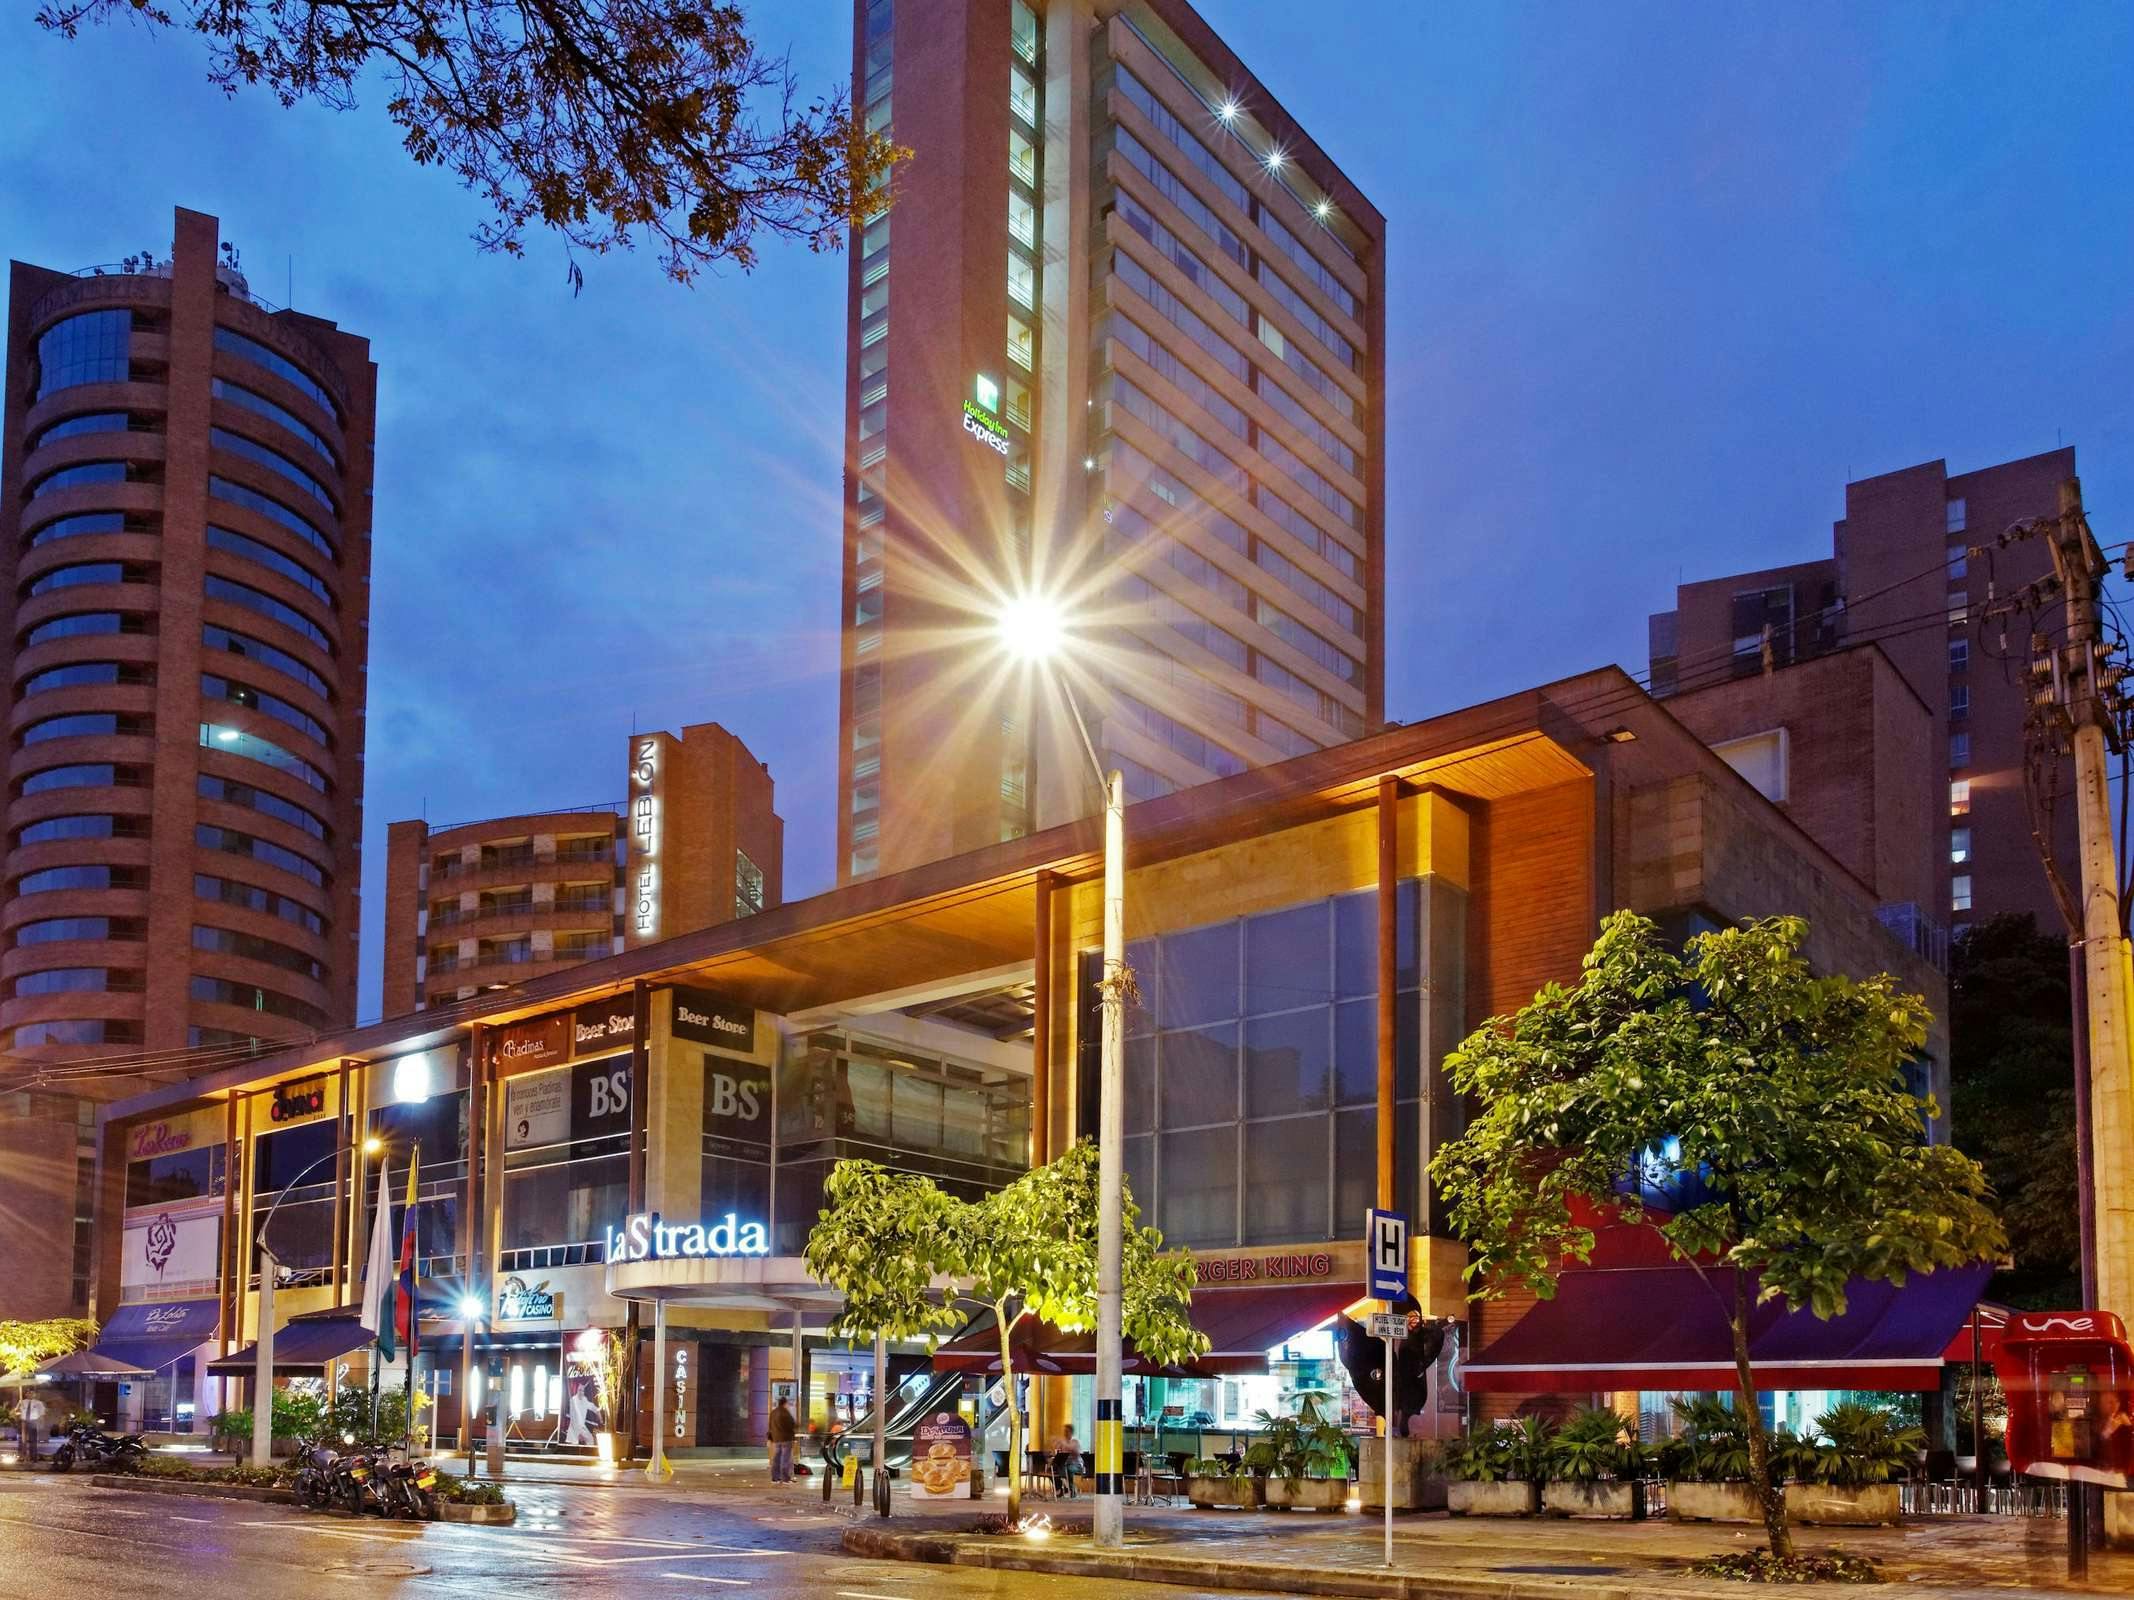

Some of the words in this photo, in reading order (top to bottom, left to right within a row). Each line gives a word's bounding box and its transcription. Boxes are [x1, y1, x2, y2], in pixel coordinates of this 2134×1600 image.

[963, 400, 996, 431] Holiday
[995, 421, 1008, 438] Inn
[963, 412, 1010, 455] Express
[637, 864, 651, 930] HOTEL
[575, 1022, 606, 1042] Beer
[678, 1006, 710, 1027] Beer
[712, 1014, 747, 1035] Store
[629, 1213, 769, 1259] Strada
[1382, 1223, 1399, 1266] H
[1264, 1253, 1329, 1277] KING
[526, 1304, 553, 1315] CASINO
[2022, 1317, 2093, 1331] une
[675, 1350, 687, 1438] CASINO
